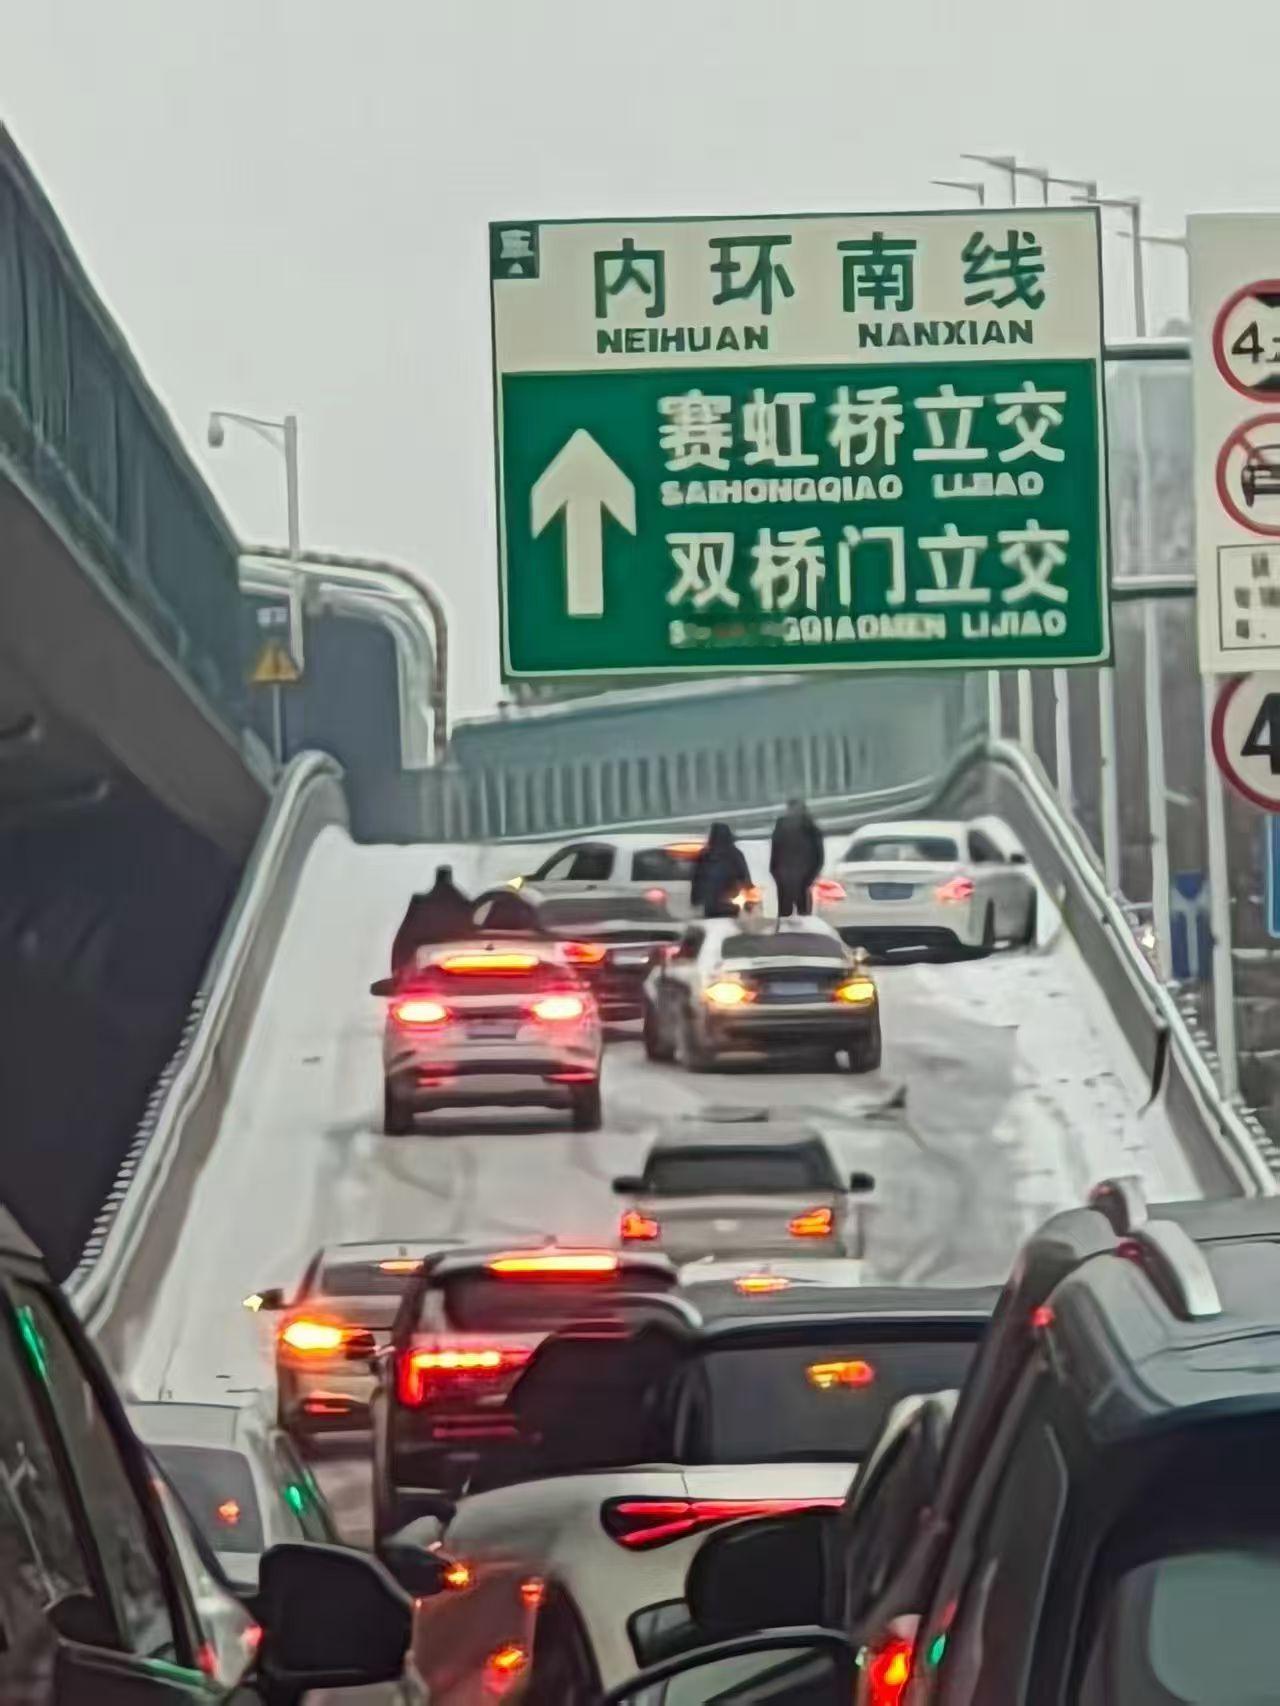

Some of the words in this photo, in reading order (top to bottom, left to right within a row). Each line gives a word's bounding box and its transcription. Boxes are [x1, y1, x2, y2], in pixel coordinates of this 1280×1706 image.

[593, 230, 1046, 319] 内环南线
[596, 325, 769, 354] NEIHUAN
[858, 319, 1033, 348] NANXIAN
[658, 381, 1067, 472] 赛虹桥立交
[665, 520, 1070, 610] 双桥门立交
[961, 609, 1068, 640] LIJIAO
